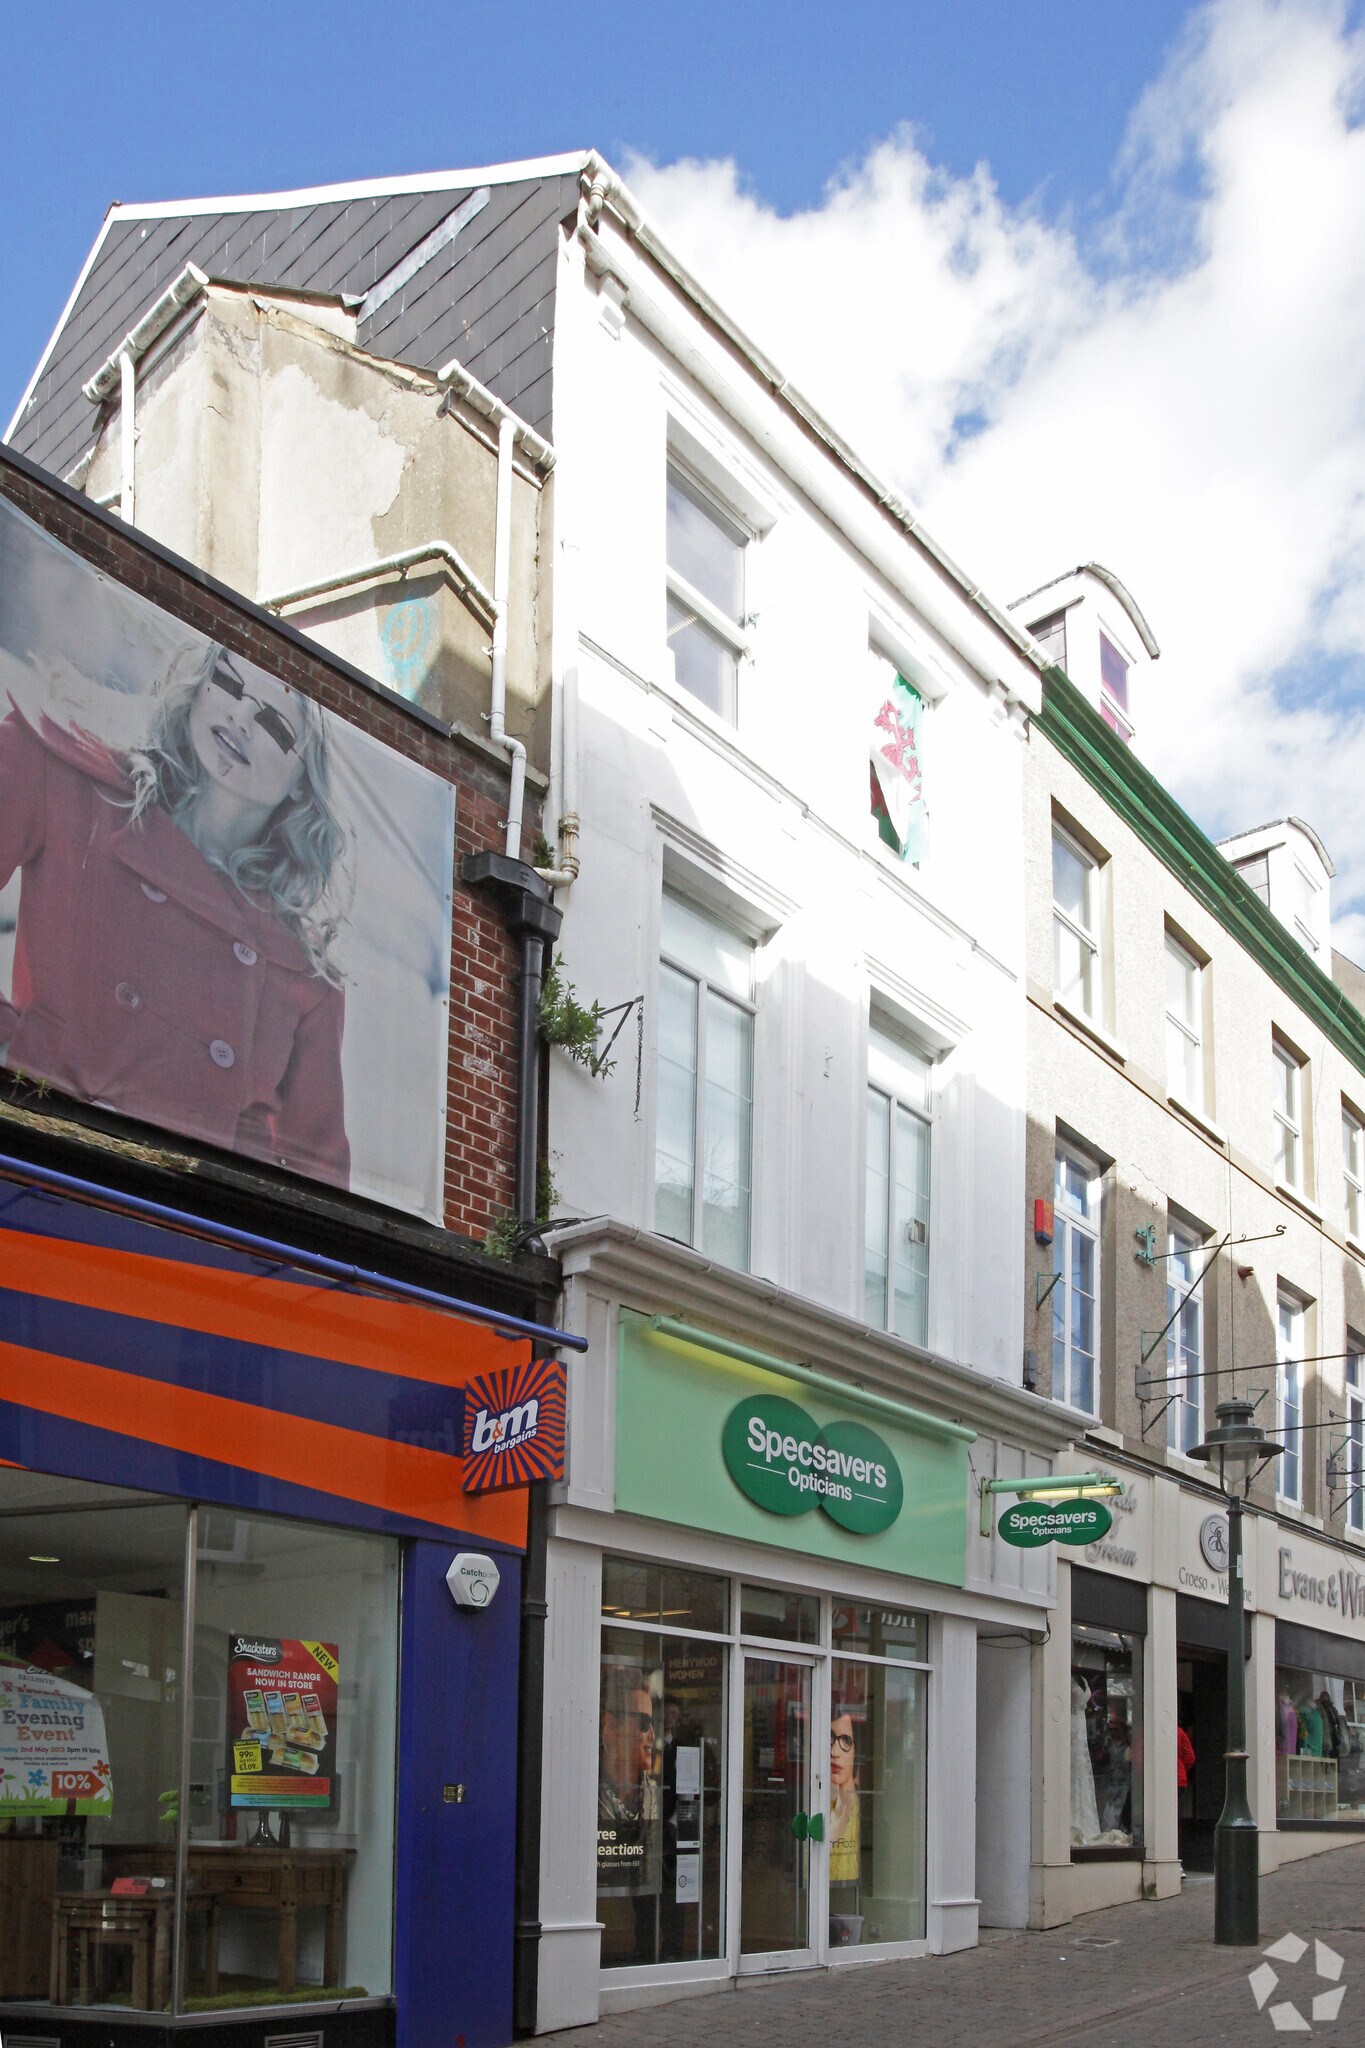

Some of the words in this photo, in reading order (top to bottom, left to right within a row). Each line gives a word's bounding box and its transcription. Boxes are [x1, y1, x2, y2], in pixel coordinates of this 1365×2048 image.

[472, 1399, 538, 1452] b&m
[494, 1428, 537, 1453] bargains
[747, 1416, 887, 1488] Specsavers
[788, 1466, 853, 1501] Opticians
[1009, 1511, 1097, 1530] Specsavers
[1032, 1526, 1072, 1537] Opticians
[1178, 1566, 1208, 1591] Croeso
[1278, 1546, 1326, 1604] Evans
[1327, 1574, 1339, 1609] &
[234, 1637, 277, 1657] Snacksters
[312, 1646, 336, 1671] NEW
[246, 1667, 291, 1679] SANDWICH
[293, 1672, 321, 1682] RANGE
[255, 1678, 276, 1687] NOW
[278, 1680, 286, 1688] IN
[288, 1681, 313, 1690] STORE
[669, 1668, 705, 1681] WOMEN
[19, 1694, 85, 1714] Family
[2, 1709, 85, 1730] Evening
[16, 1726, 76, 1742] Event
[34, 1746, 49, 1755] May
[66, 1746, 81, 1754] 5pm
[239, 1751, 254, 1759] 99p
[56, 1774, 91, 1790] 10%
